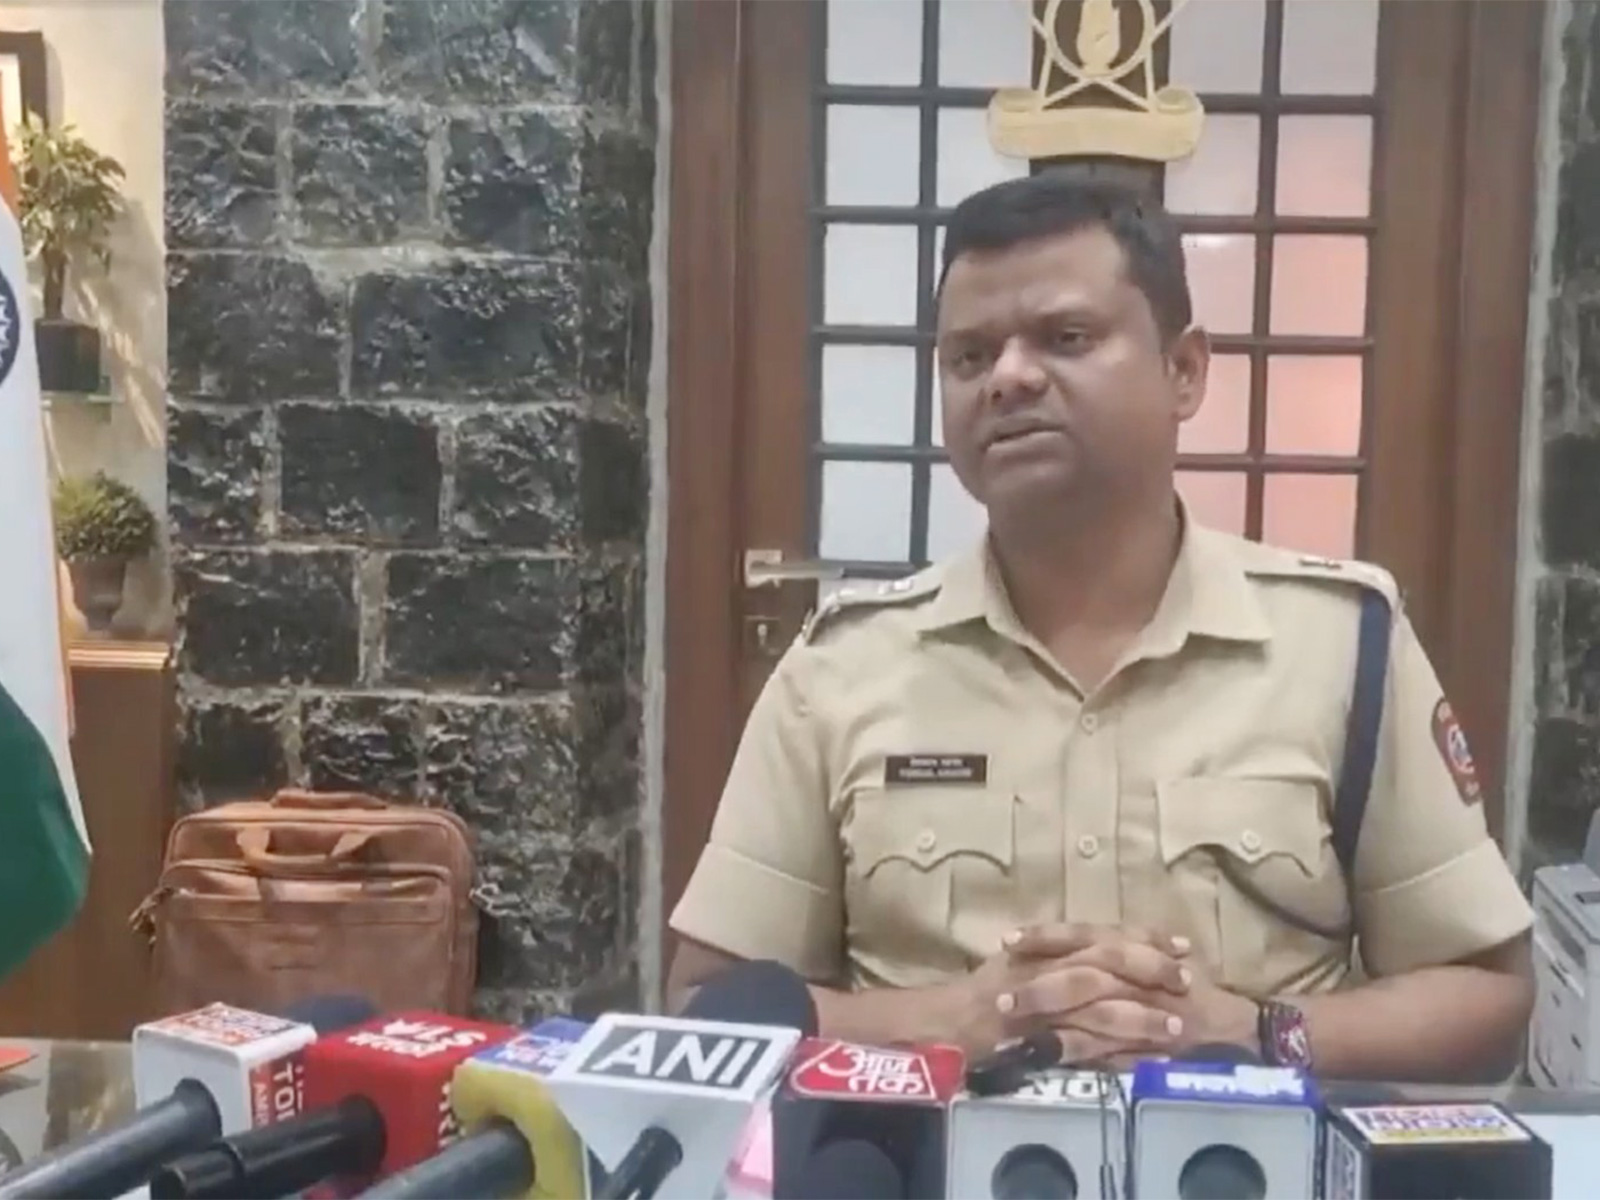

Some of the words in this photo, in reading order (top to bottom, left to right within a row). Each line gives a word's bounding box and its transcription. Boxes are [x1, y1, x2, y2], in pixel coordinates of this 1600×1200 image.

[590, 1029, 760, 1086] ANI
[818, 1048, 914, 1077] आज
[848, 1073, 926, 1095] तक
